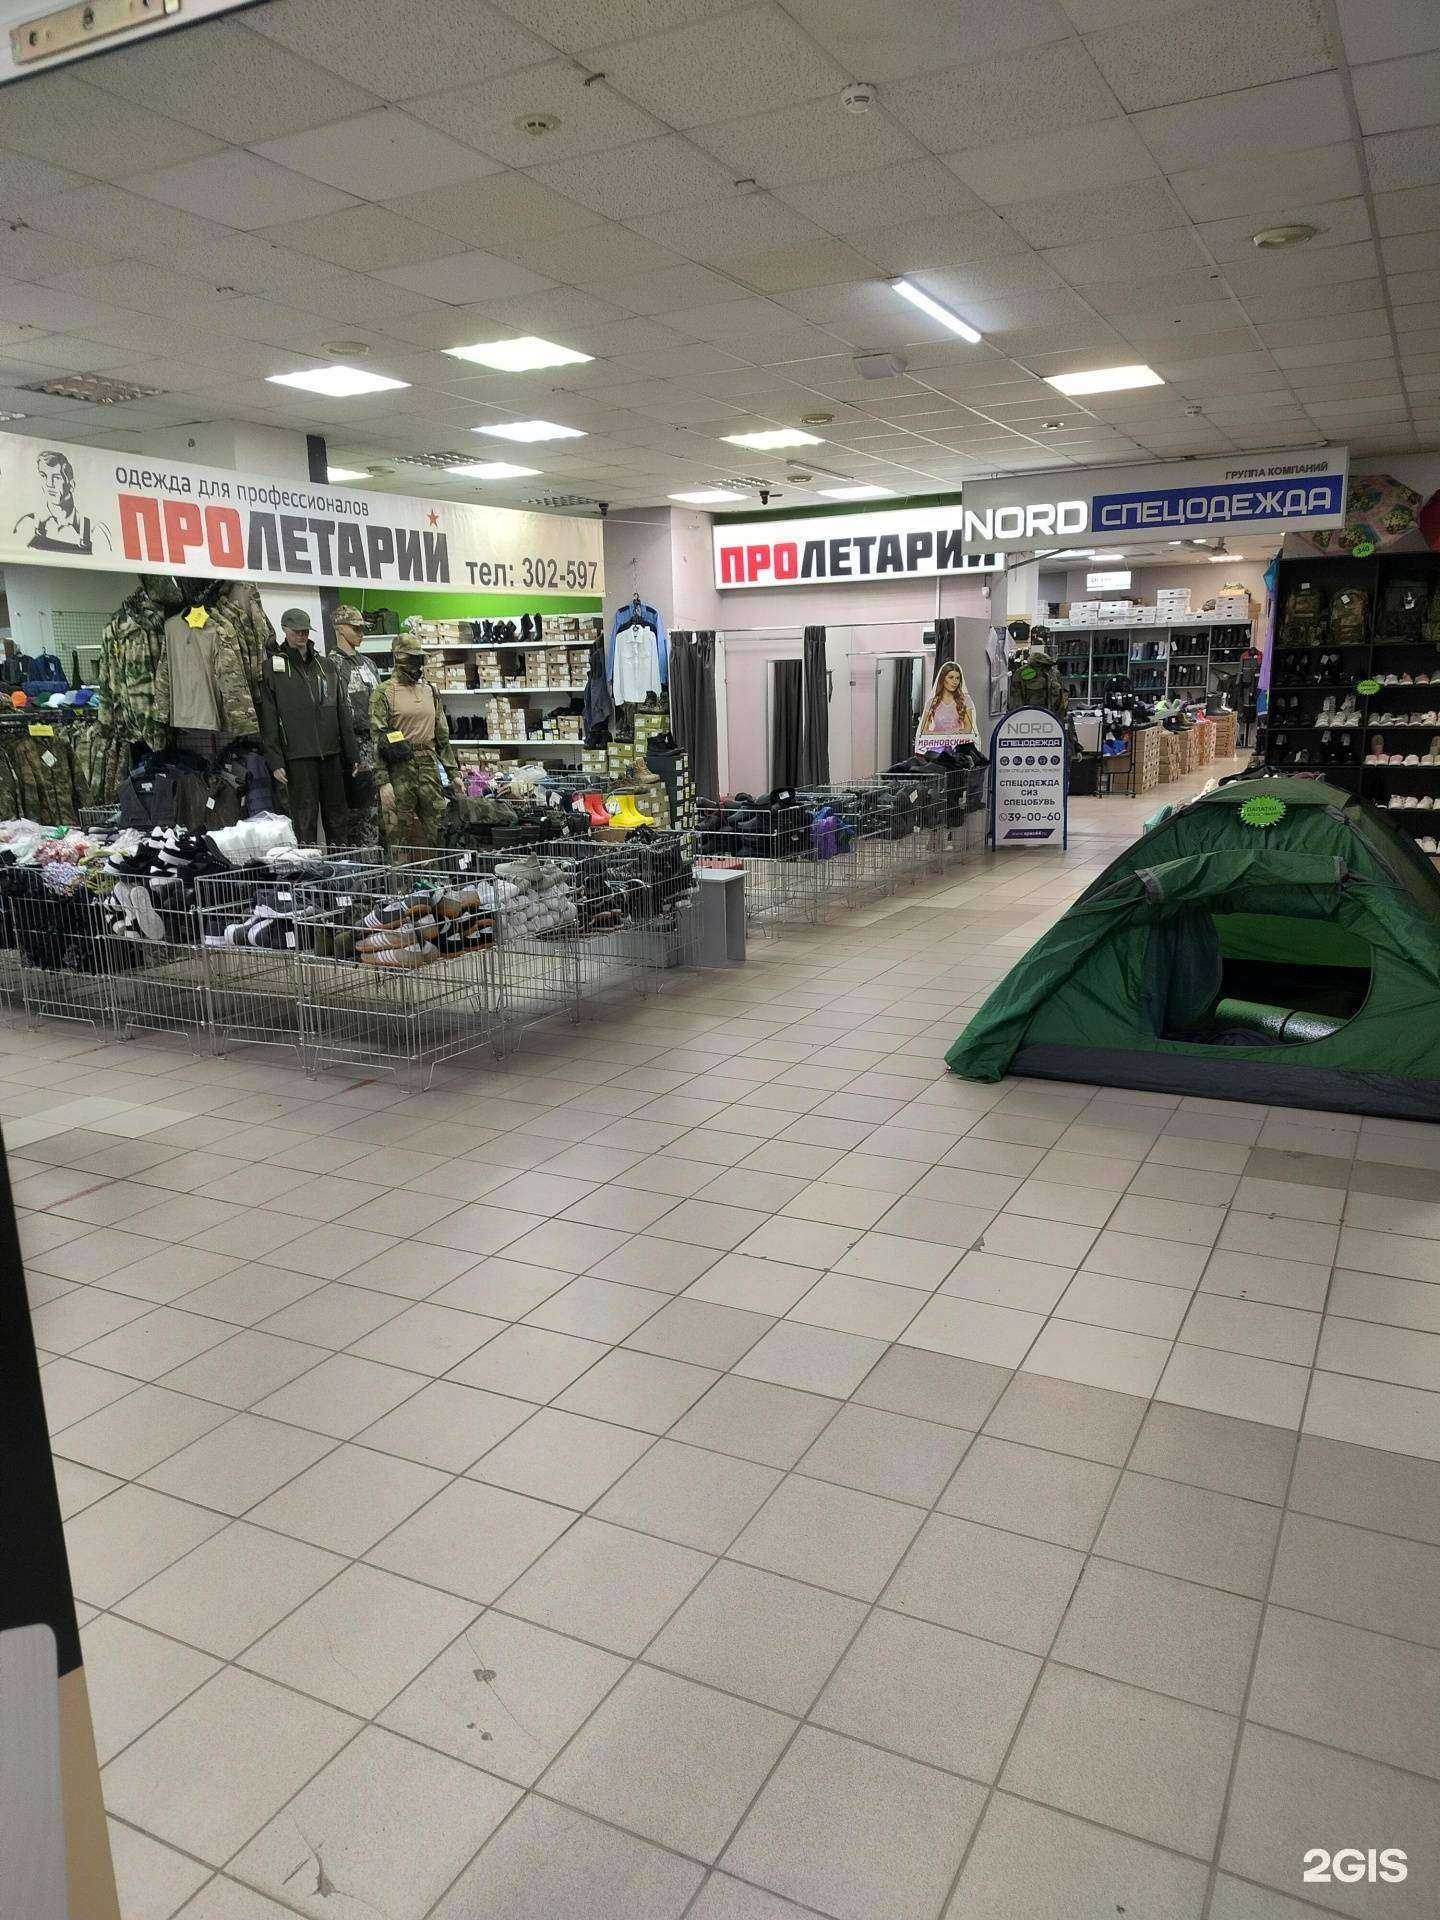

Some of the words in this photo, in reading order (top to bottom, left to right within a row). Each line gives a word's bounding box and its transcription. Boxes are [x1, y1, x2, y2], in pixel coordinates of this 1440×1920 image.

[1225, 469, 1266, 480] ГРУППА
[1267, 461, 1329, 476] КОМПАНИЙ
[115, 465, 191, 495] одежда
[198, 479, 231, 499] для
[236, 484, 369, 517] профессионалов
[1101, 486, 1332, 526] СПЕЦОДЕЖДА
[964, 499, 1088, 542] NORD
[465, 559, 514, 587] тел:
[522, 556, 598, 589] 302-597
[1007, 722, 1054, 734] NORD
[1001, 739, 1060, 747] СПЕЦОДЕЖДА
[999, 779, 1060, 789] СПЕЦОДЕЖДА
[1021, 789, 1038, 797] СИЗ
[1003, 799, 1056, 807] СПЕЦОБУВЬ
[1007, 811, 1061, 822] 39-00-60
